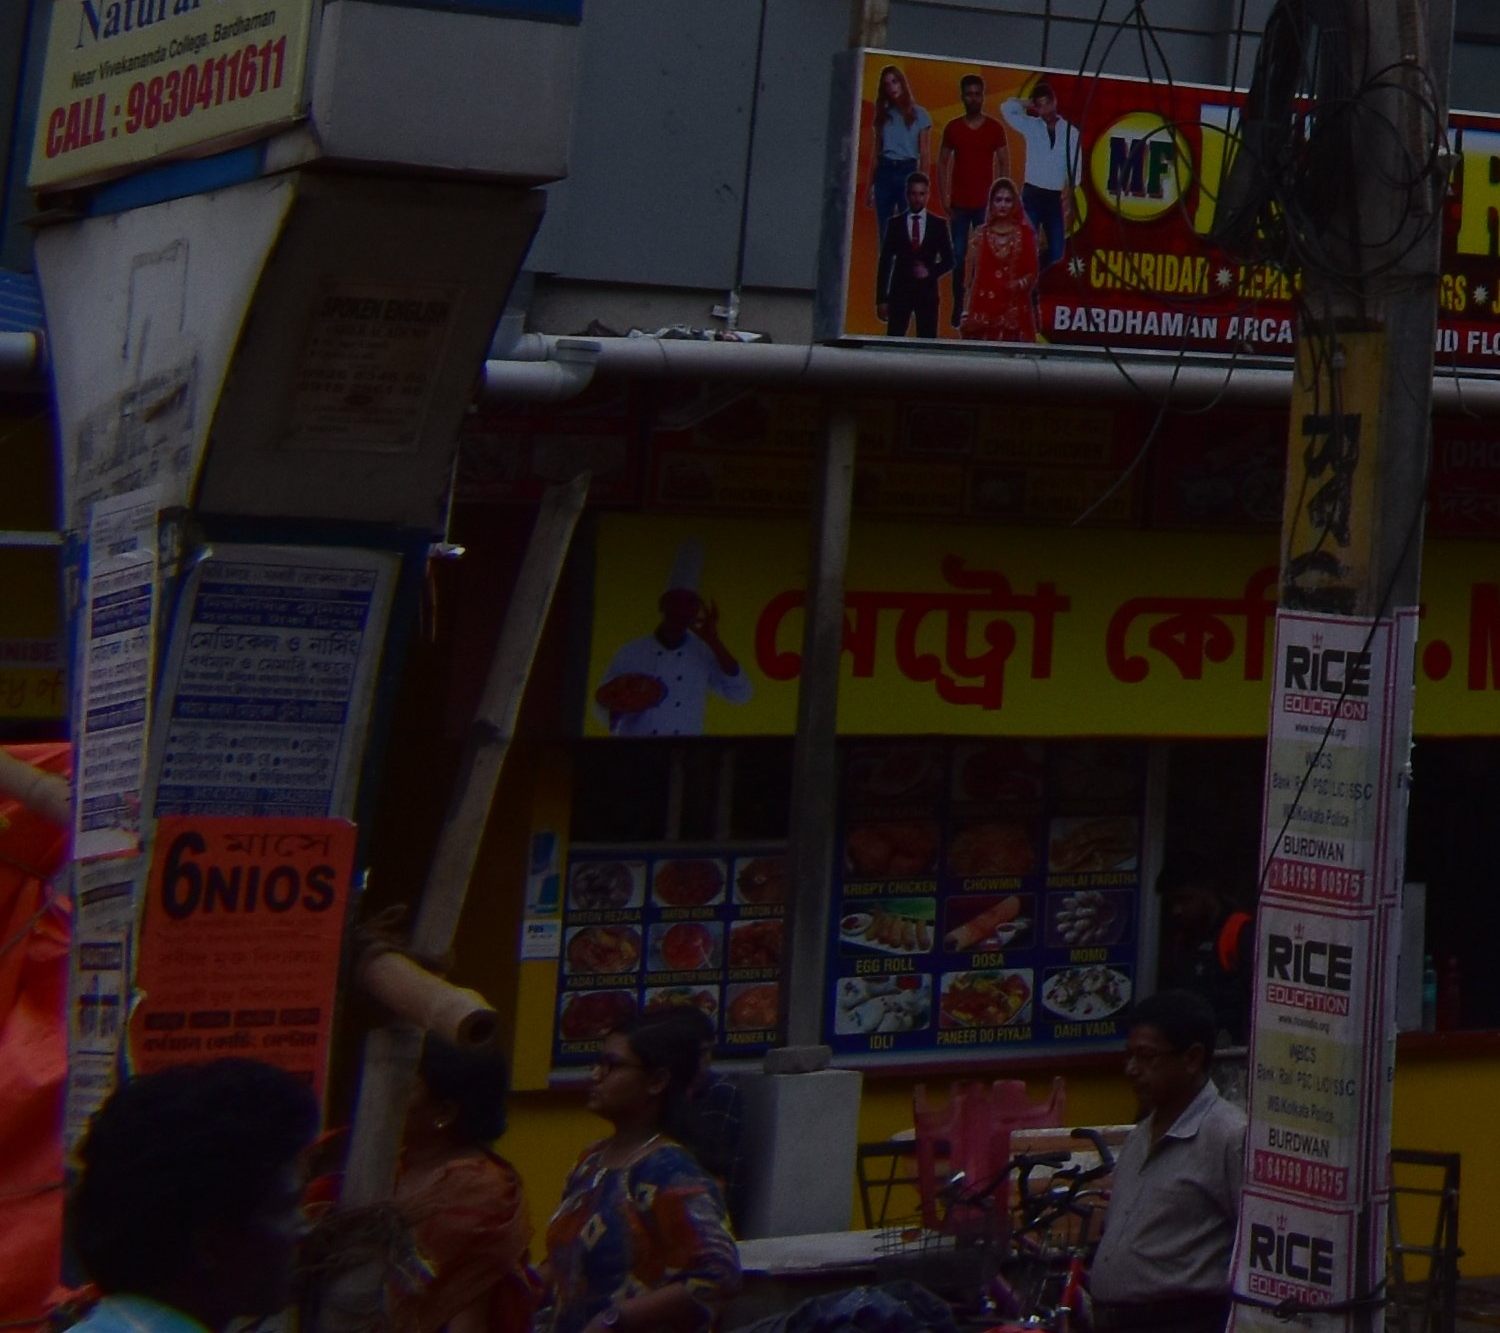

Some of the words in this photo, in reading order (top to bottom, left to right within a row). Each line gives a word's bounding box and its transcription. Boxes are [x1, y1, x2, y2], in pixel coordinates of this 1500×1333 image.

[72, 67, 95, 89] Near
[100, 47, 166, 80] Vivekananda
[214, 10, 276, 43] Bardhaman
[47, 93, 106, 158] CALL
[126, 35, 286, 133] 9830411611
[1107, 136, 1174, 200] MF
[1090, 248, 1210, 295] CHURIDAR
[320, 296, 383, 320] SPOKEN
[383, 298, 451, 323] ENGLISH
[1053, 304, 1218, 339] BARDHAMAN
[1226, 314, 1294, 345] ARCA
[191, 626, 279, 652] মেডিকেল
[288, 636, 300, 652] ও
[1284, 693, 1368, 721] EDUCATION
[1284, 834, 1344, 862] BURDWAN
[162, 831, 207, 920] 6
[224, 833, 331, 857] মাসে
[203, 864, 336, 913] NIOS
[844, 883, 884, 896] KRISPY
[888, 881, 936, 894] CHICKEN
[963, 878, 1021, 891] CHOWMIN
[1091, 871, 1137, 885] PARATHA
[1281, 867, 1317, 891] 84799
[1321, 870, 1360, 898] 00575
[856, 958, 880, 973] EGG
[884, 957, 914, 972] ROLL
[972, 953, 1005, 968] DOSA
[1070, 948, 1107, 962] MOMO
[1266, 983, 1350, 1016] EDUCATION
[870, 1036, 894, 1050] IDLI
[937, 1030, 979, 1045] PANEER
[984, 1029, 995, 1043] DO
[1054, 1023, 1080, 1038] DAHI
[1084, 1021, 1116, 1035] VADA
[1289, 1043, 1317, 1064] WBCS
[1268, 1128, 1329, 1158] BURDWAN
[1265, 1160, 1302, 1186] 84799
[1306, 1167, 1344, 1197] 00575
